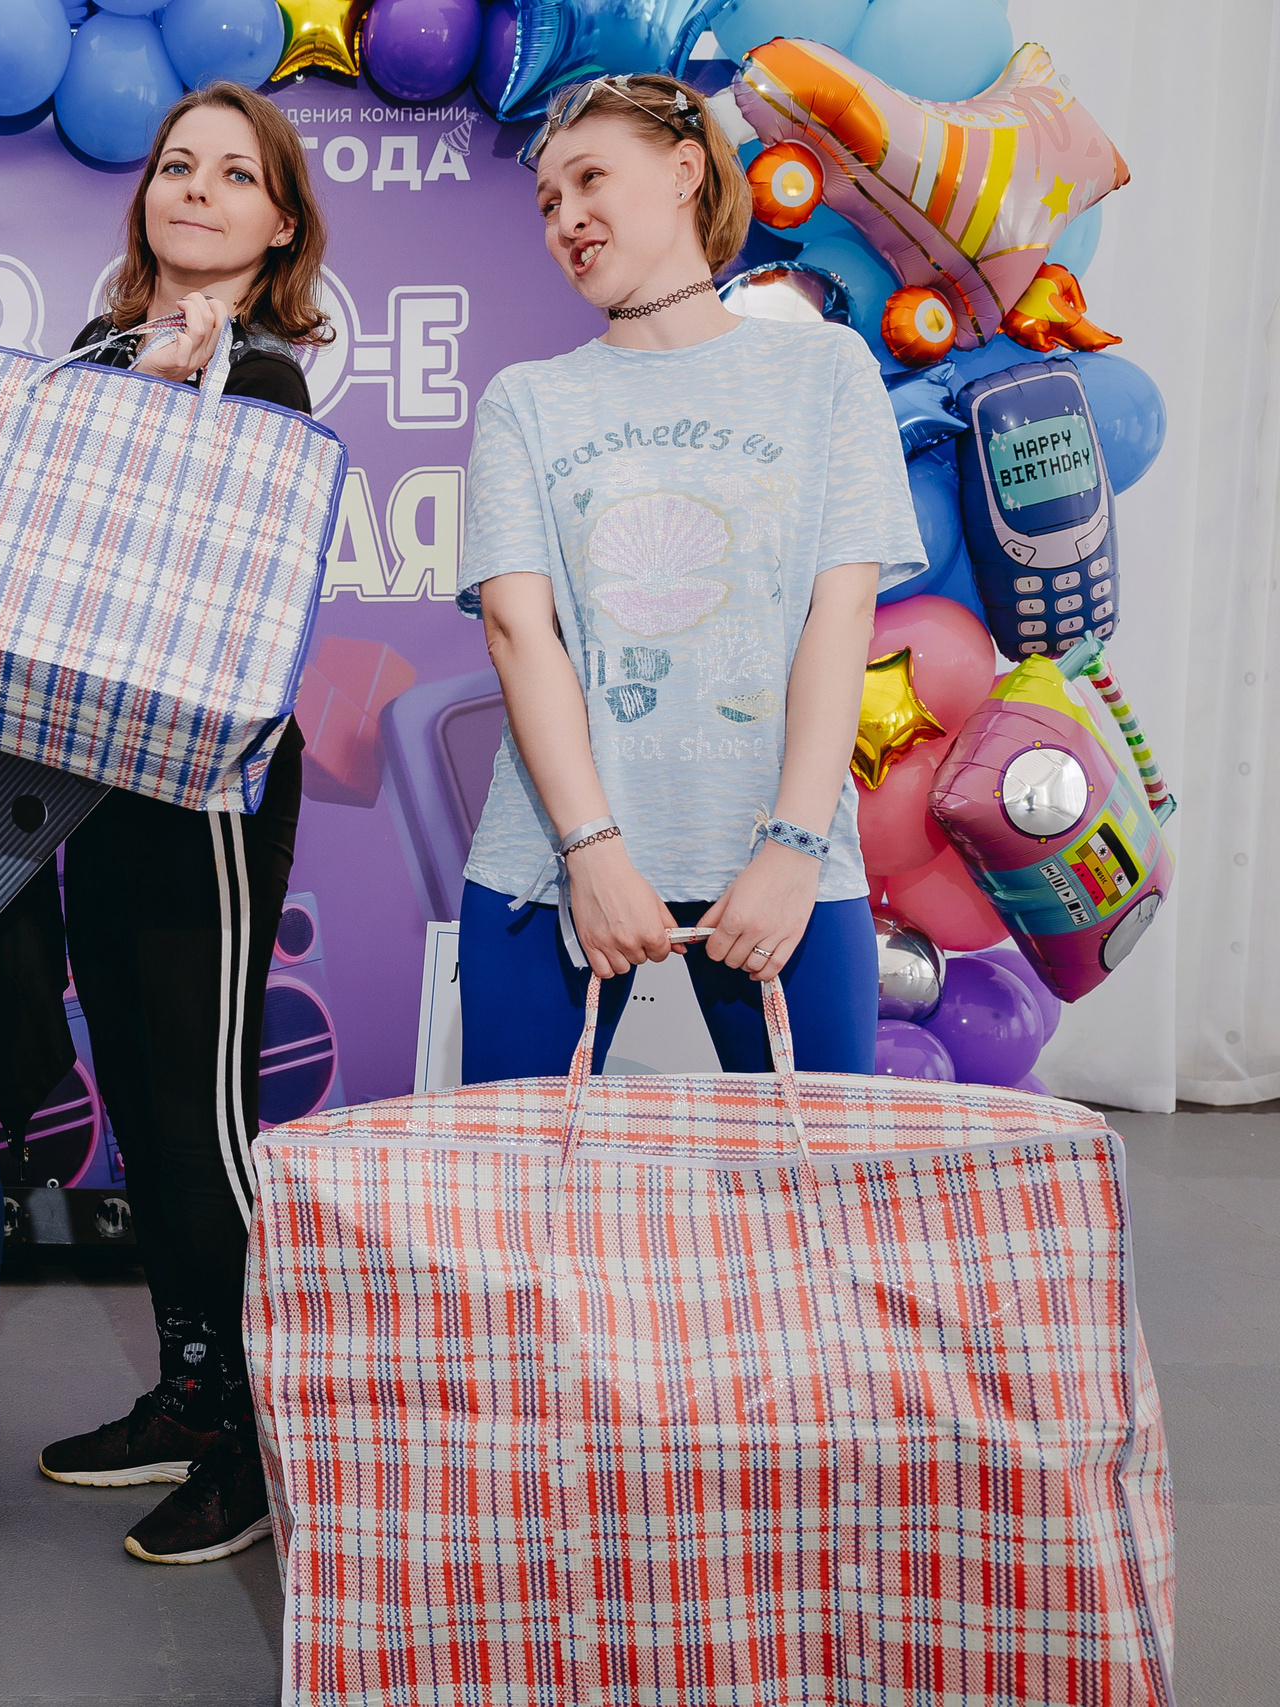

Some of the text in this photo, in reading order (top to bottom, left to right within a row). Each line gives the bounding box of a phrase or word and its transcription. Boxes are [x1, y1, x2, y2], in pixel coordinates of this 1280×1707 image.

[280, 107, 468, 126] дения компании
[1013, 429, 1072, 461] HAPPY
[999, 447, 1090, 487] BIRTHDAY
[1093, 866, 1108, 885] MUSIC
